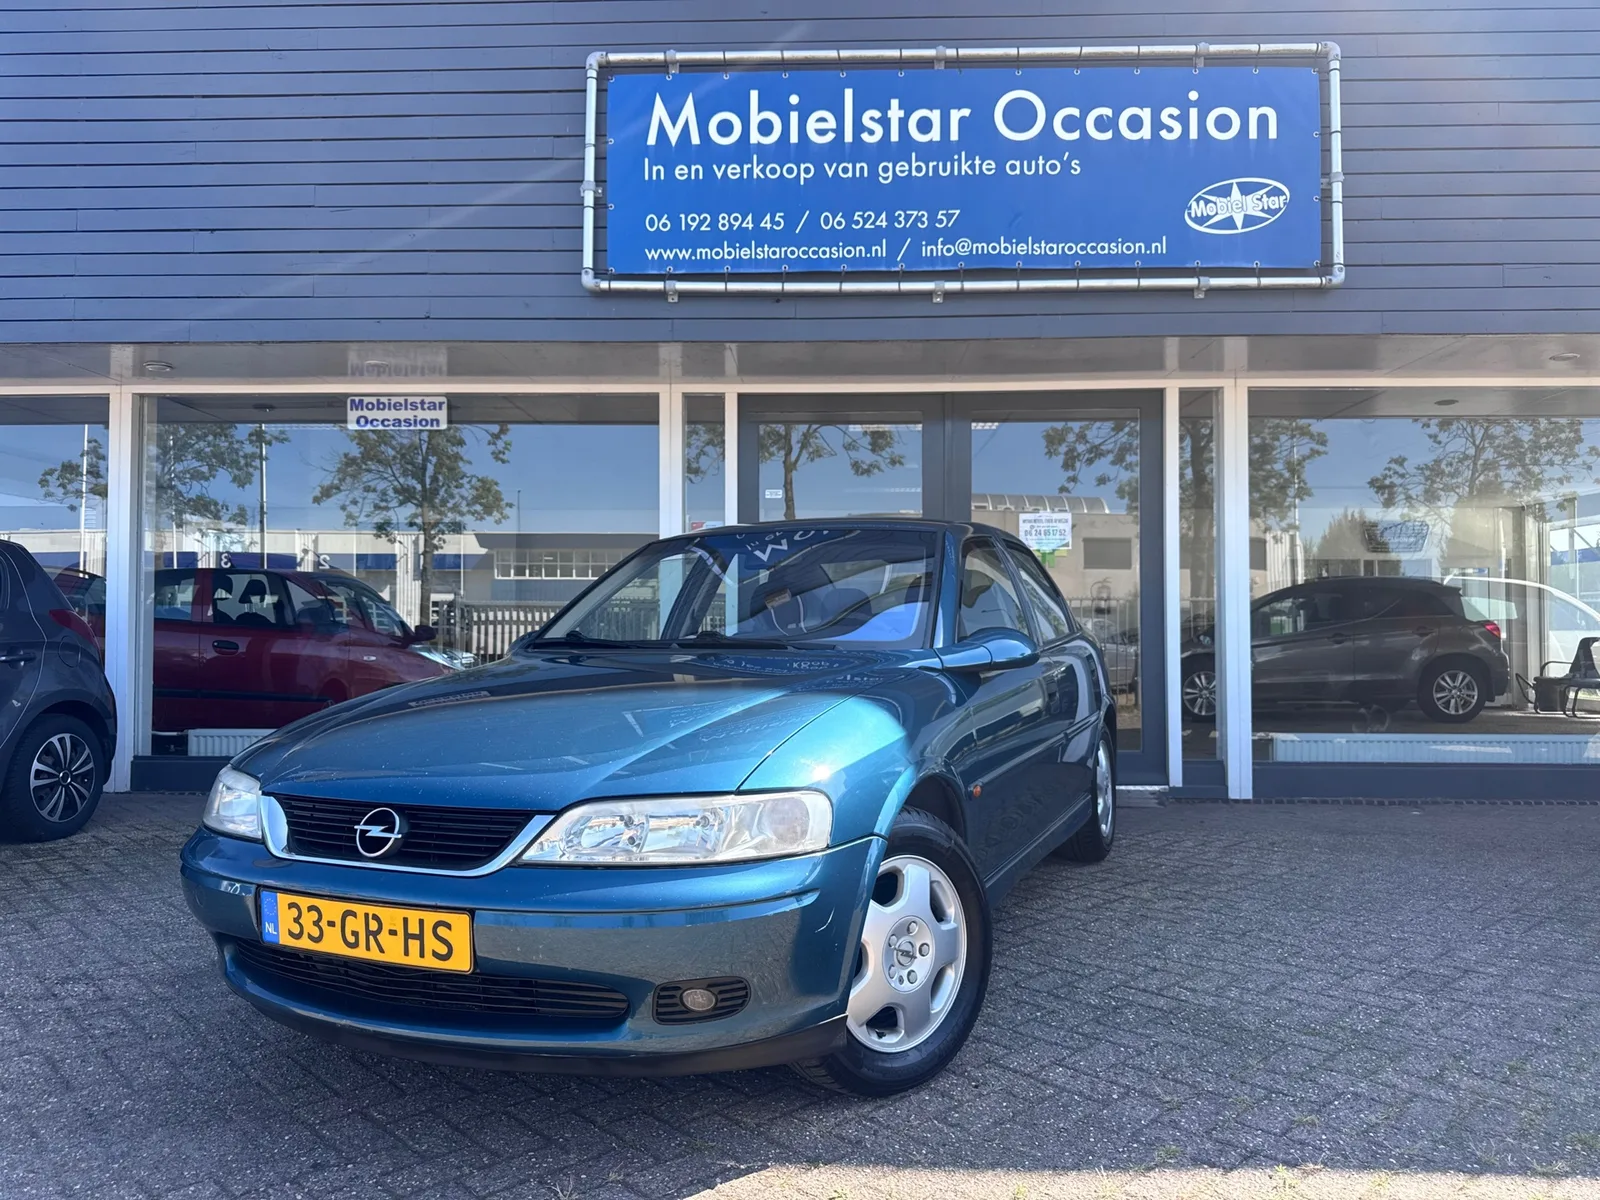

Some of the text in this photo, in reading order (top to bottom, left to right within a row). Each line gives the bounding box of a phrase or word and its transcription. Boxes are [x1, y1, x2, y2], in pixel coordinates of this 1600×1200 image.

[647, 89, 1278, 146] Mobielstar Occasion
[645, 151, 1081, 185] In en verkoop van gebruikte auto's
[1191, 193, 1287, 218] Mobiel Star
[645, 209, 961, 233] 06 192 894 45 / 06 524 373 57
[645, 236, 1166, 261] www.mobielstaroccasion.nl / info@mobielstaroccasion.nl
[349, 398, 446, 412] Mobielstar
[355, 415, 440, 428] Occasion
[1034, 529, 1042, 537] 24
[265, 921, 278, 936] NL
[287, 901, 454, 962] 33-GR-HS
